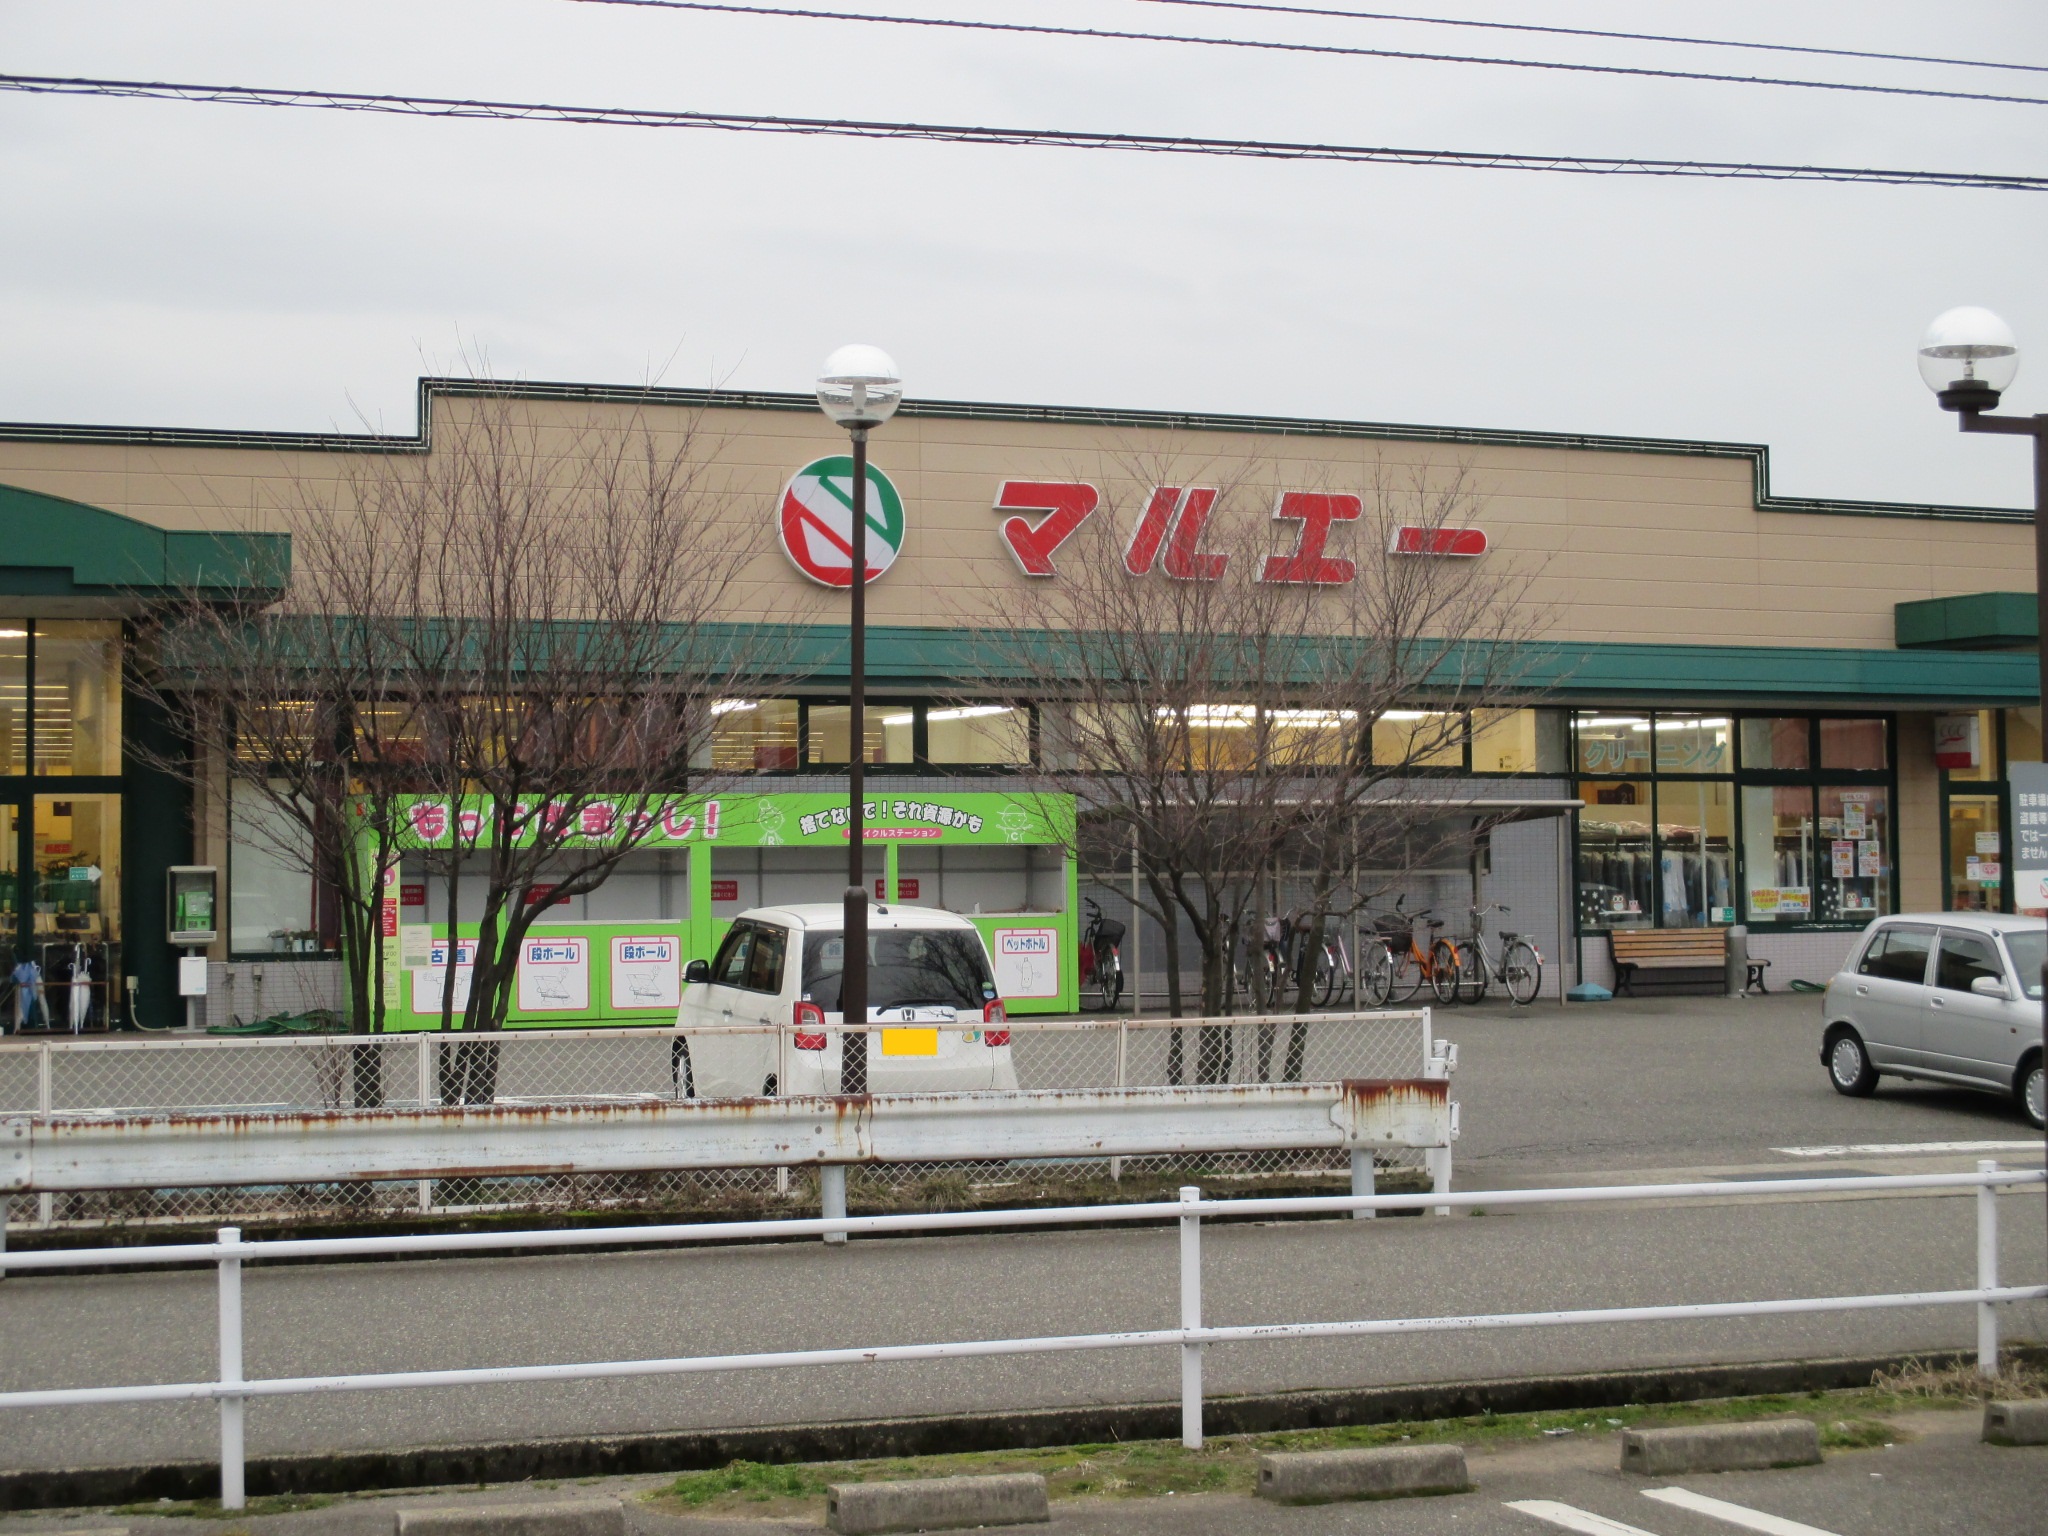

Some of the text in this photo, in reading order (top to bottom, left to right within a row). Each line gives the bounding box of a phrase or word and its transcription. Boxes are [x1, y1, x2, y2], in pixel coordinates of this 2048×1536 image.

[993, 480, 1488, 585] マルエー
[1585, 740, 1727, 768] クリーニング
[2019, 793, 2048, 807] 駐車場
[847, 829, 936, 838] イクルステーション
[1006, 937, 1046, 951] ペットボトル
[531, 946, 576, 962] 段ボール
[624, 945, 667, 960] 段ボール
